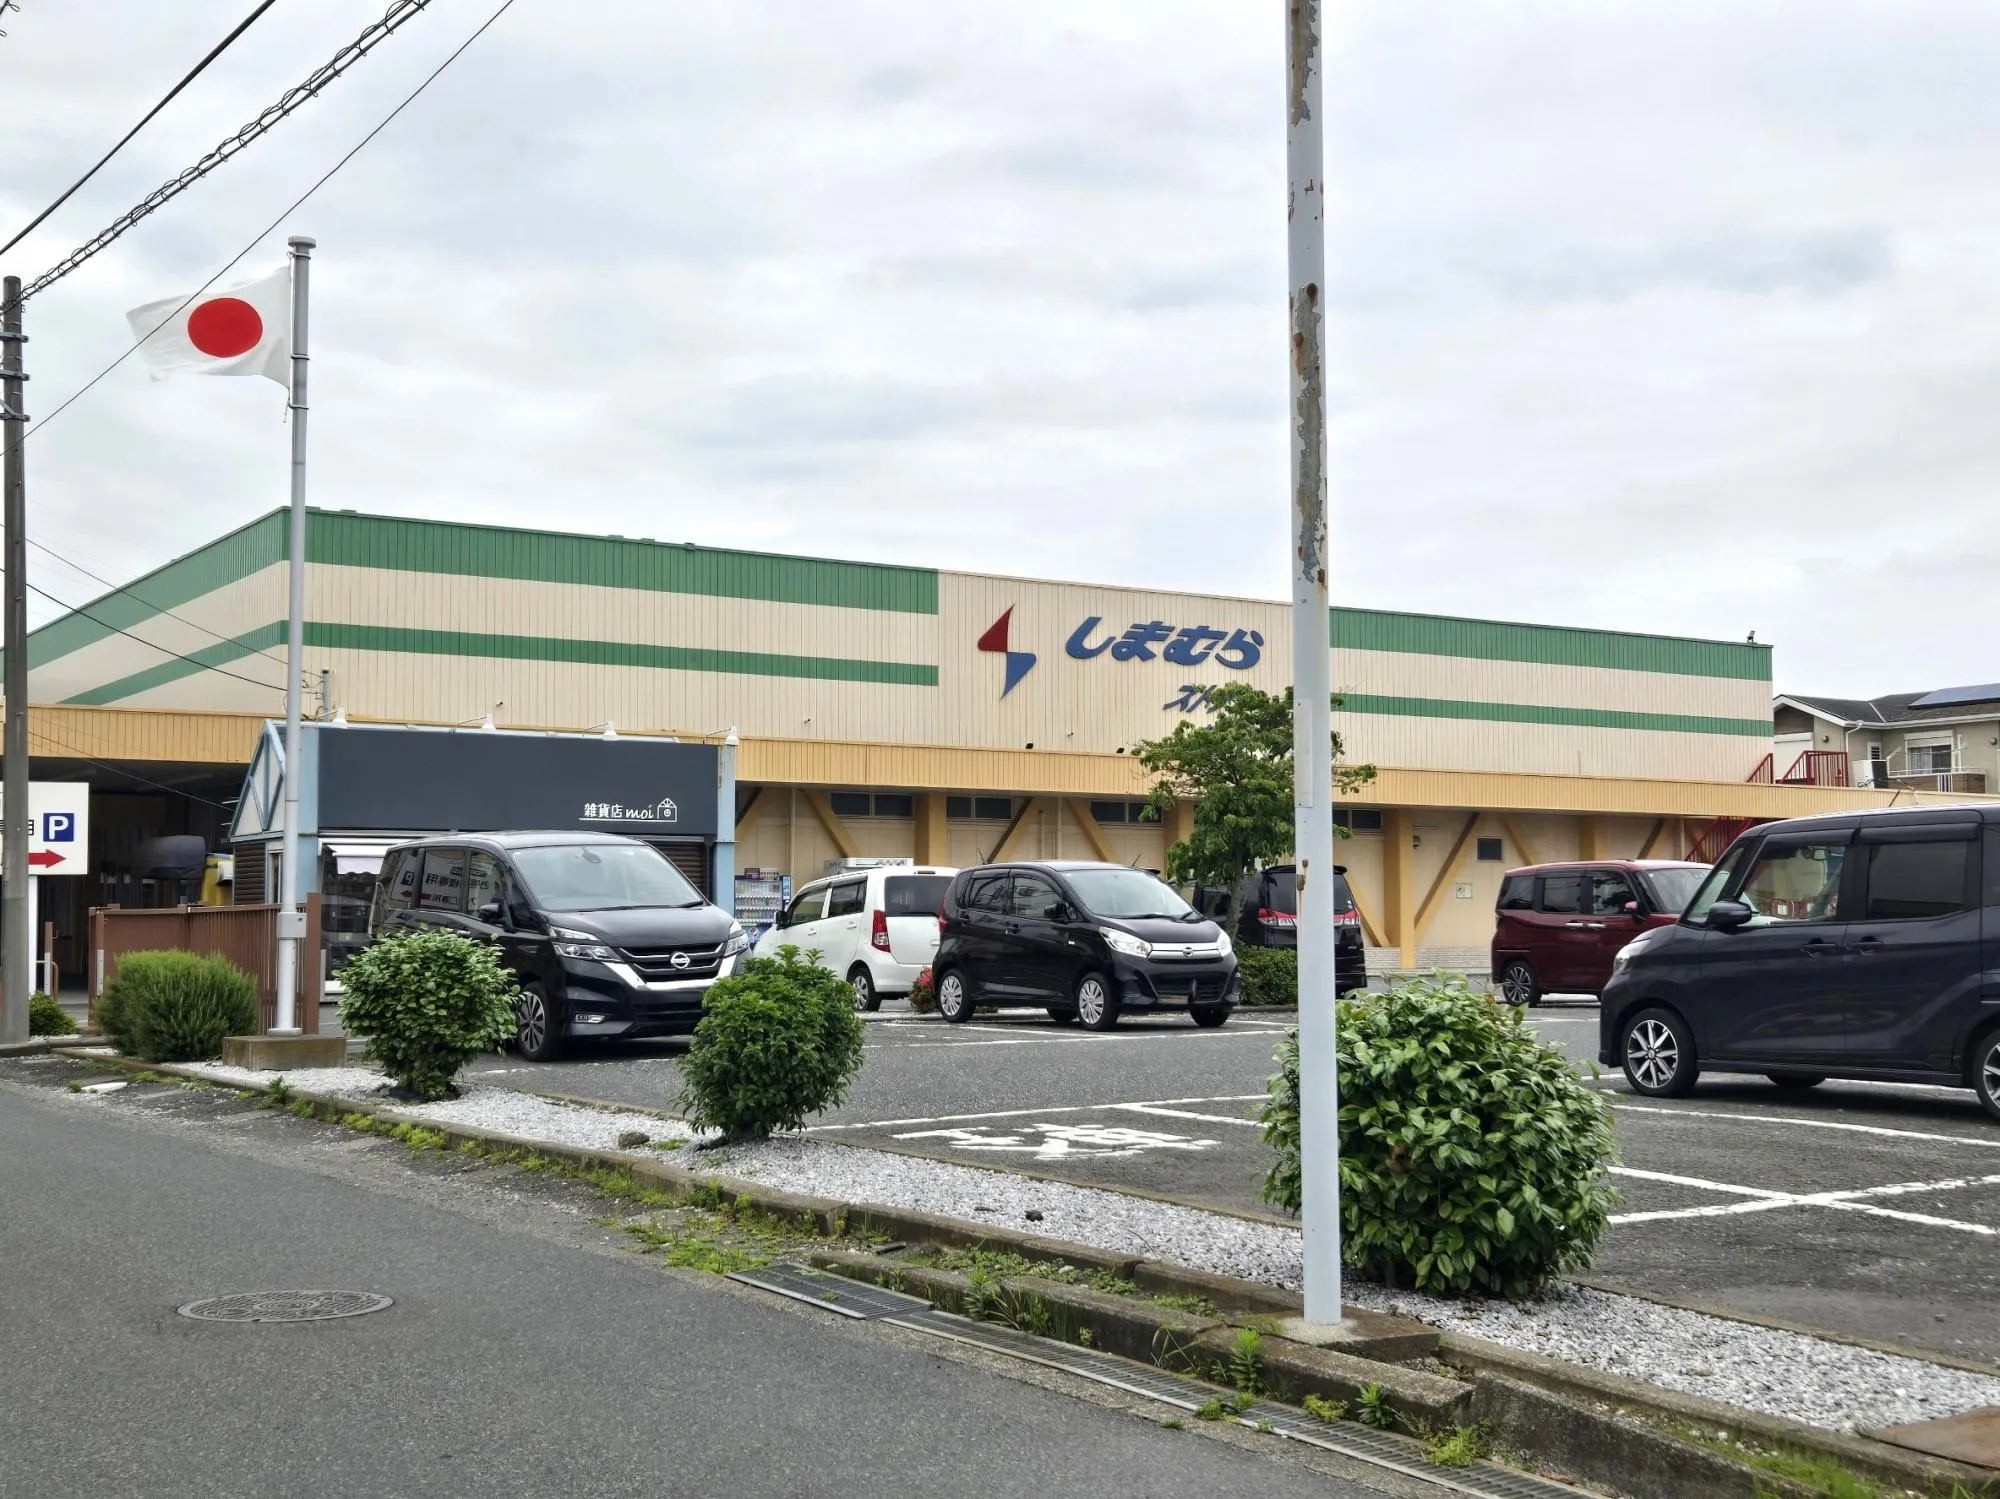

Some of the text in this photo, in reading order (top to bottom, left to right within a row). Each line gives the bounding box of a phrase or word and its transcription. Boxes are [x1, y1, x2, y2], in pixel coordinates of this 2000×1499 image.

[1065, 616, 1265, 669] しまむら
[584, 803, 654, 819] 雑貨店 moi
[48, 815, 69, 840] P
[891, 1122, 1223, 1160] 軽
